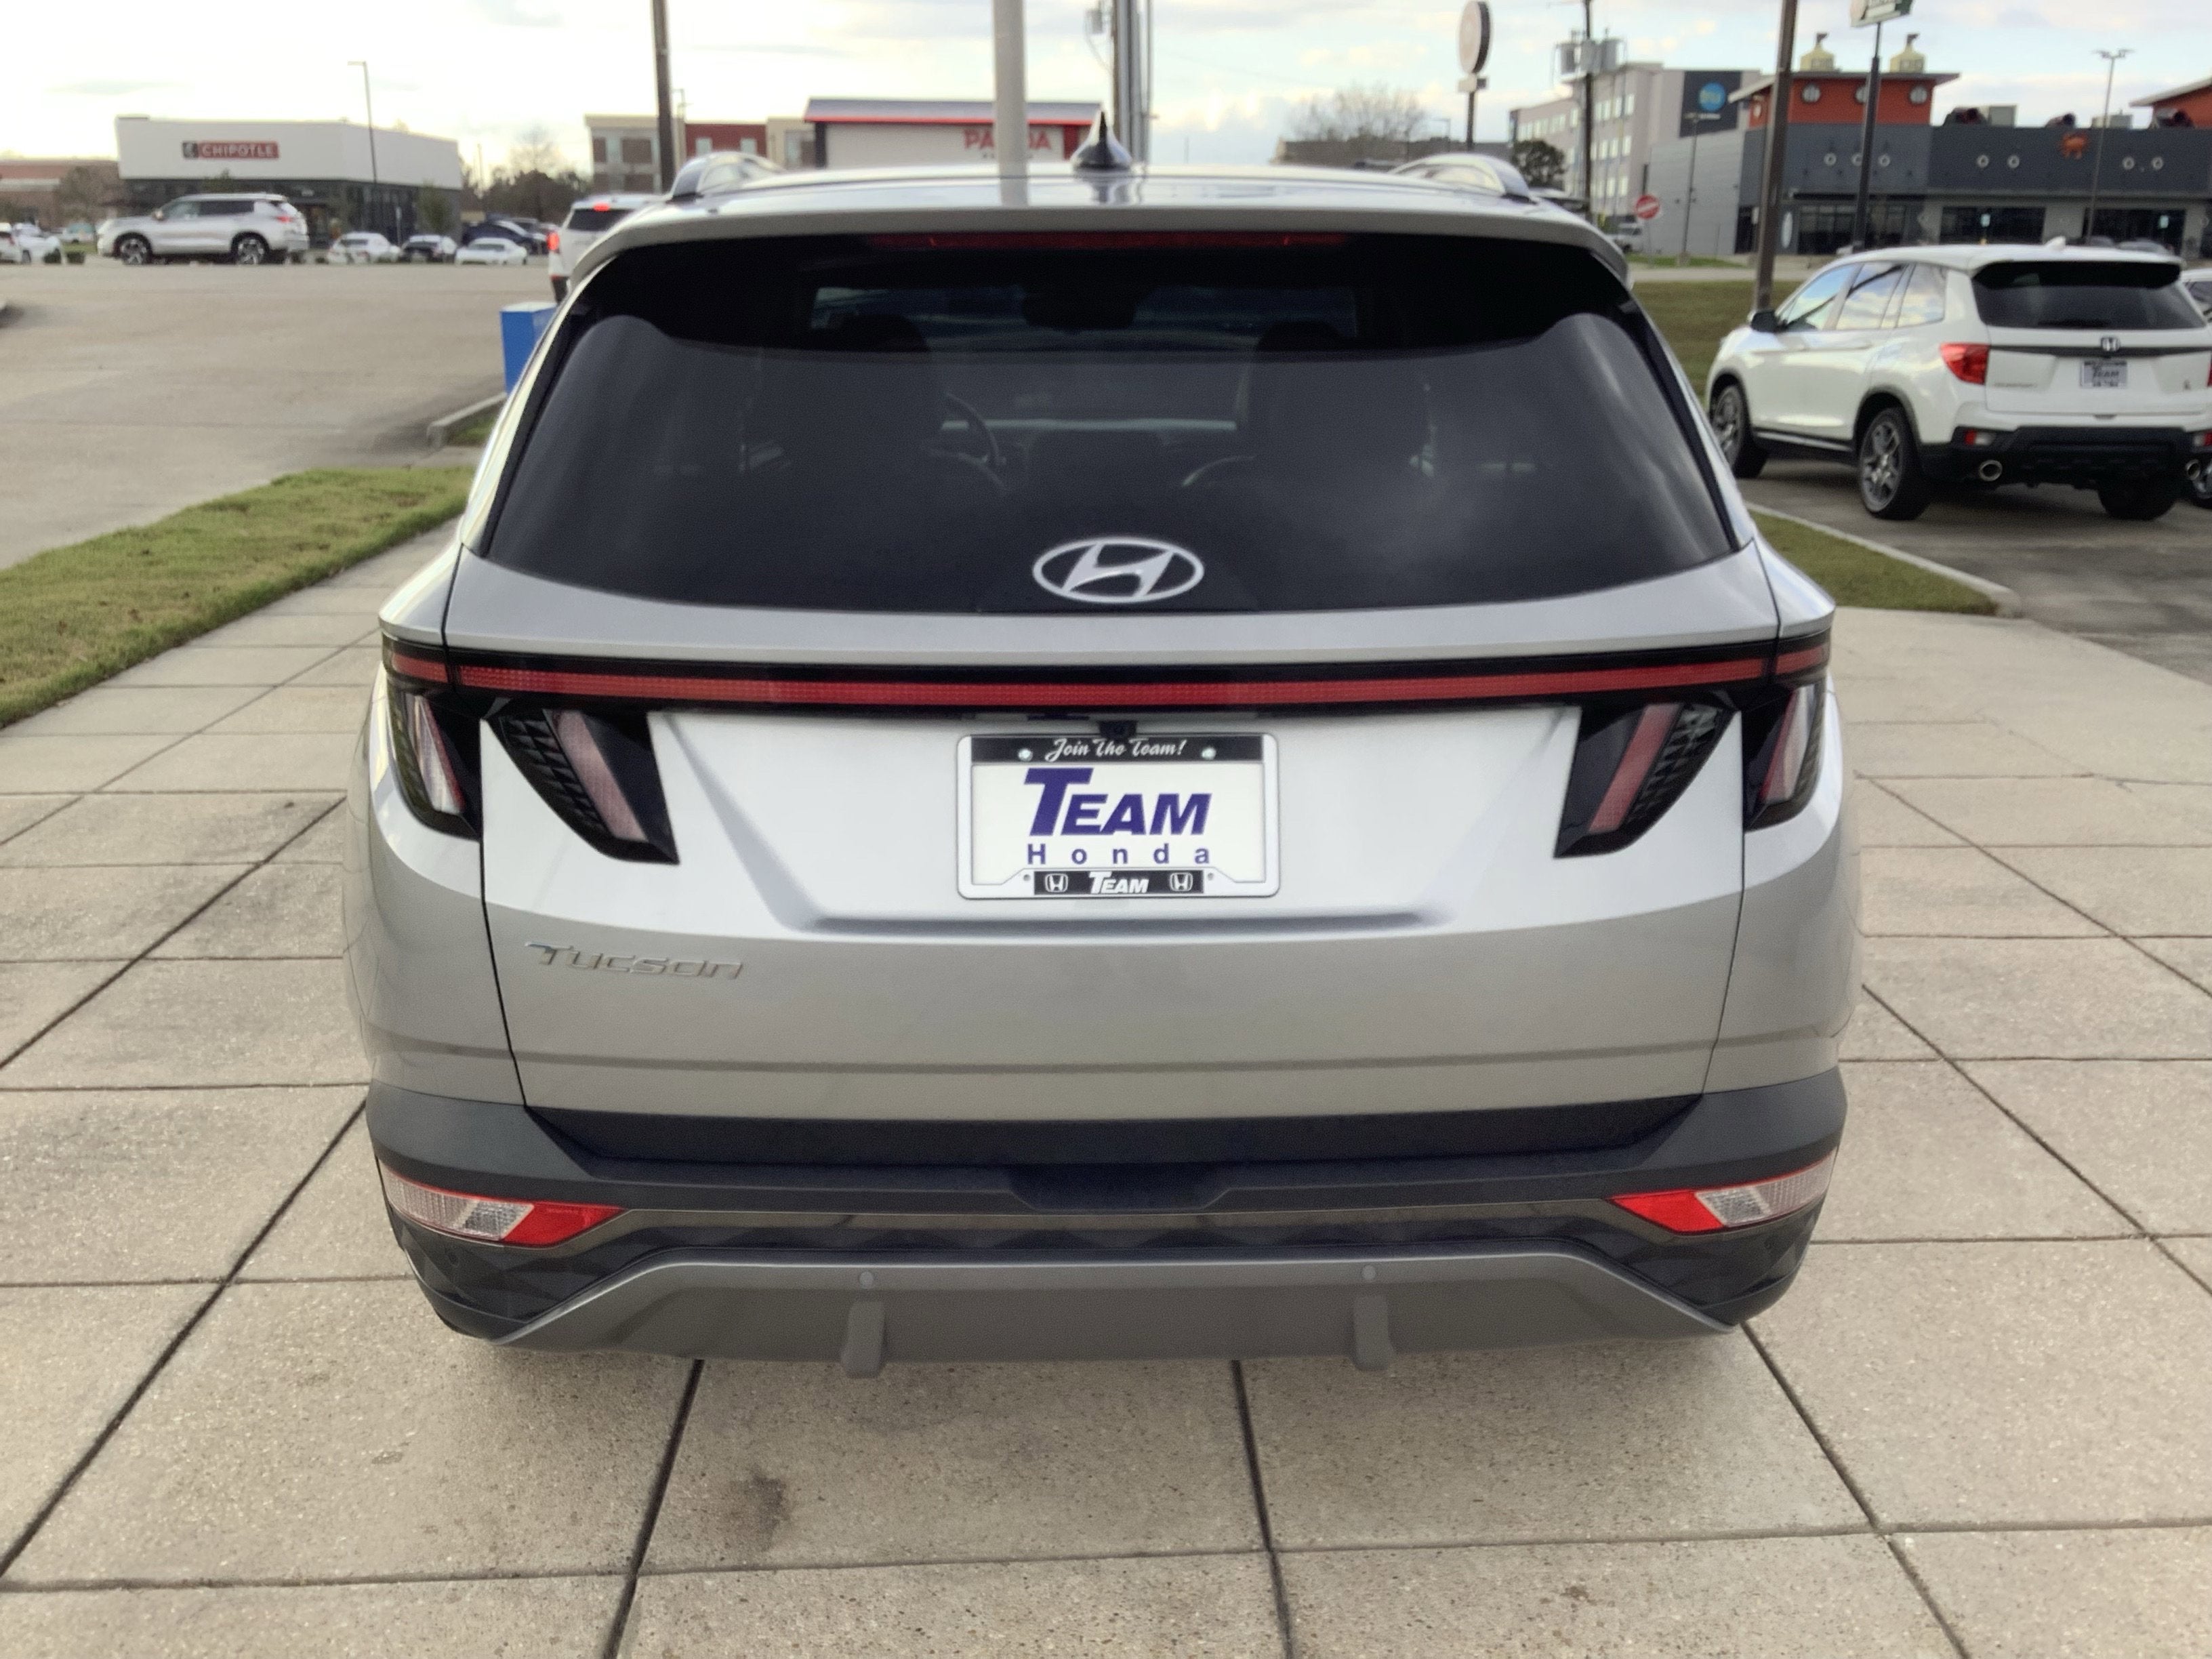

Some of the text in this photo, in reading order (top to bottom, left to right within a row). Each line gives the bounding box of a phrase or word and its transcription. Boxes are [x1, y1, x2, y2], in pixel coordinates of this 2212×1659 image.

[203, 143, 275, 157] CHIPOTLE
[1044, 738, 1187, 762] Join The Team!
[1024, 768, 1212, 836] TEAM
[1027, 843, 1210, 864] Honda
[1089, 872, 1149, 894] TEAM
